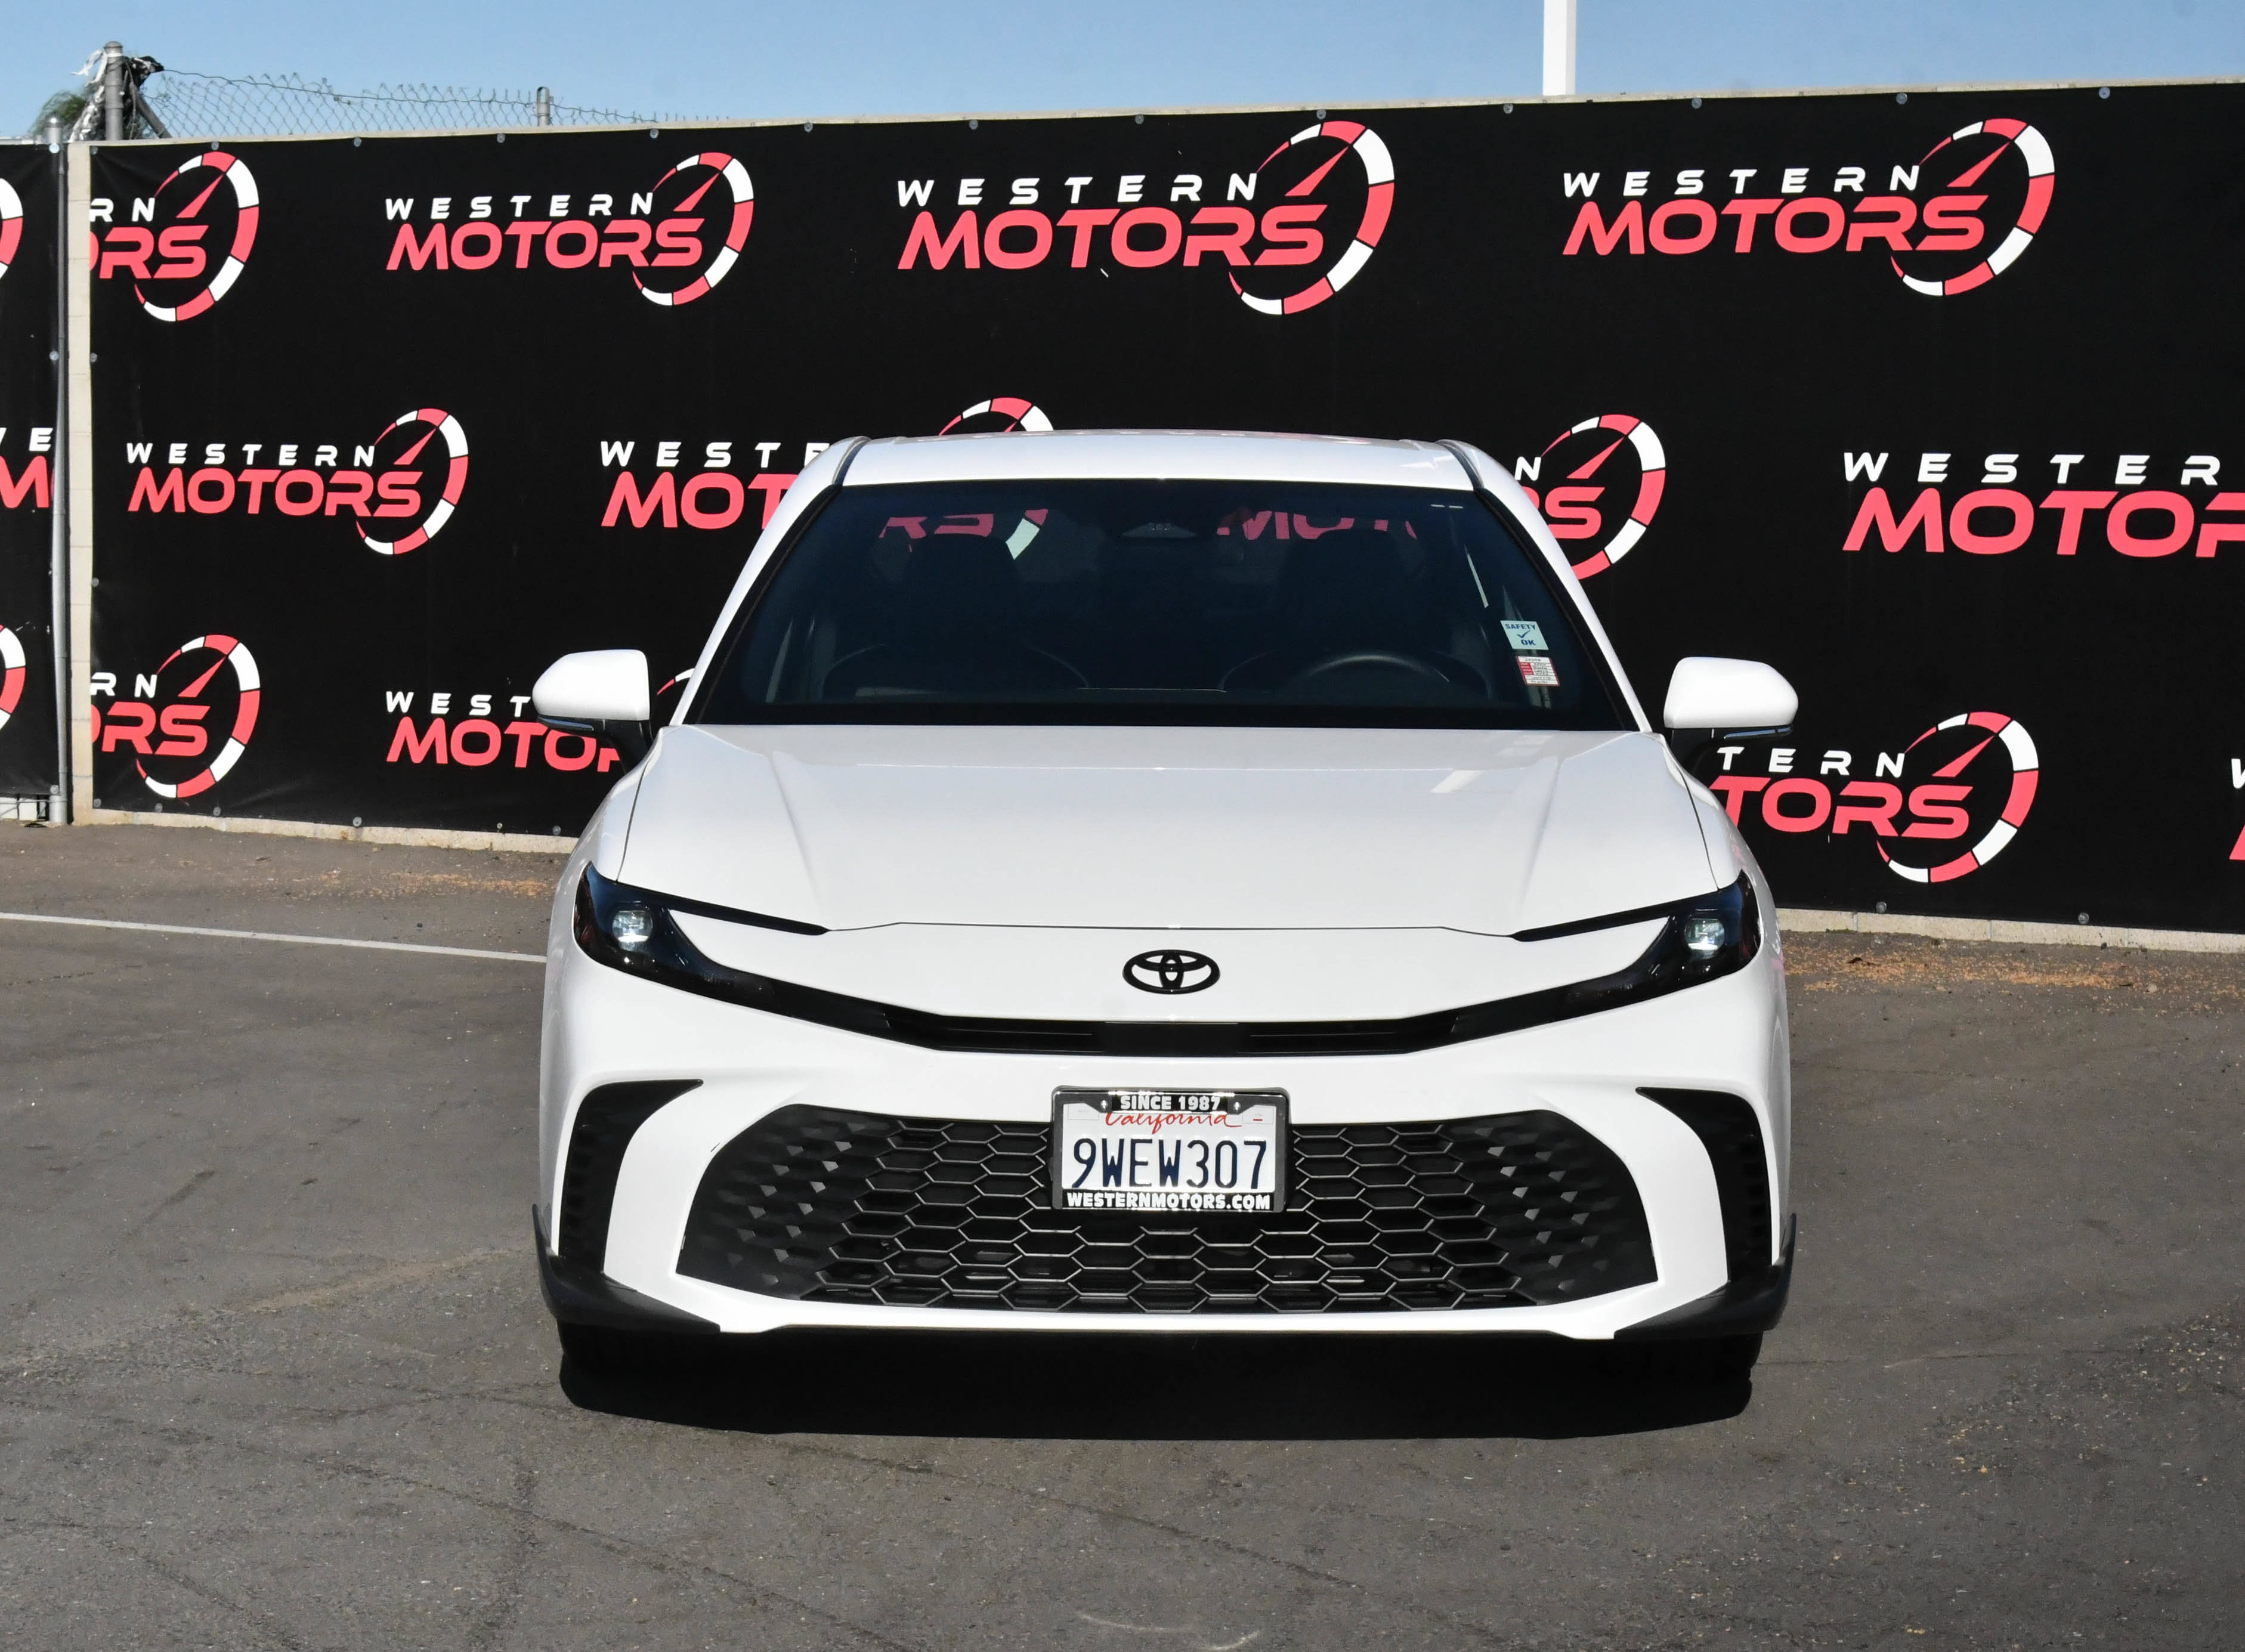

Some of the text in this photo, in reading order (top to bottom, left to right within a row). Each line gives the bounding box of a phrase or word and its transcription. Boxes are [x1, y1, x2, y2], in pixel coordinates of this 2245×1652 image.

[898, 173, 1257, 206] WESTERN
[1564, 165, 1920, 197] WESTERN
[386, 192, 653, 221] WESTERN
[1563, 194, 1989, 255] MOTORS
[90, 225, 209, 279] RS
[386, 218, 705, 270] MOTORS
[898, 204, 1328, 270] MOTORS
[126, 443, 375, 467] WESTERN
[1844, 452, 2221, 485] WESTER
[128, 467, 423, 517] MOTORS
[601, 471, 799, 530] MOT
[1522, 486, 1605, 539] S
[386, 691, 531, 717] WEST
[91, 701, 210, 756] RS
[1717, 746, 1905, 778] TERN
[1709, 775, 1973, 839] TORS
[1105, 1112, 1242, 1134] California
[1120, 1096, 1221, 1110] SINCE 1987
[1072, 1137, 1267, 1190] 9WEW307
[1066, 1192, 1270, 1211] WESTERNMOTORS.COM
